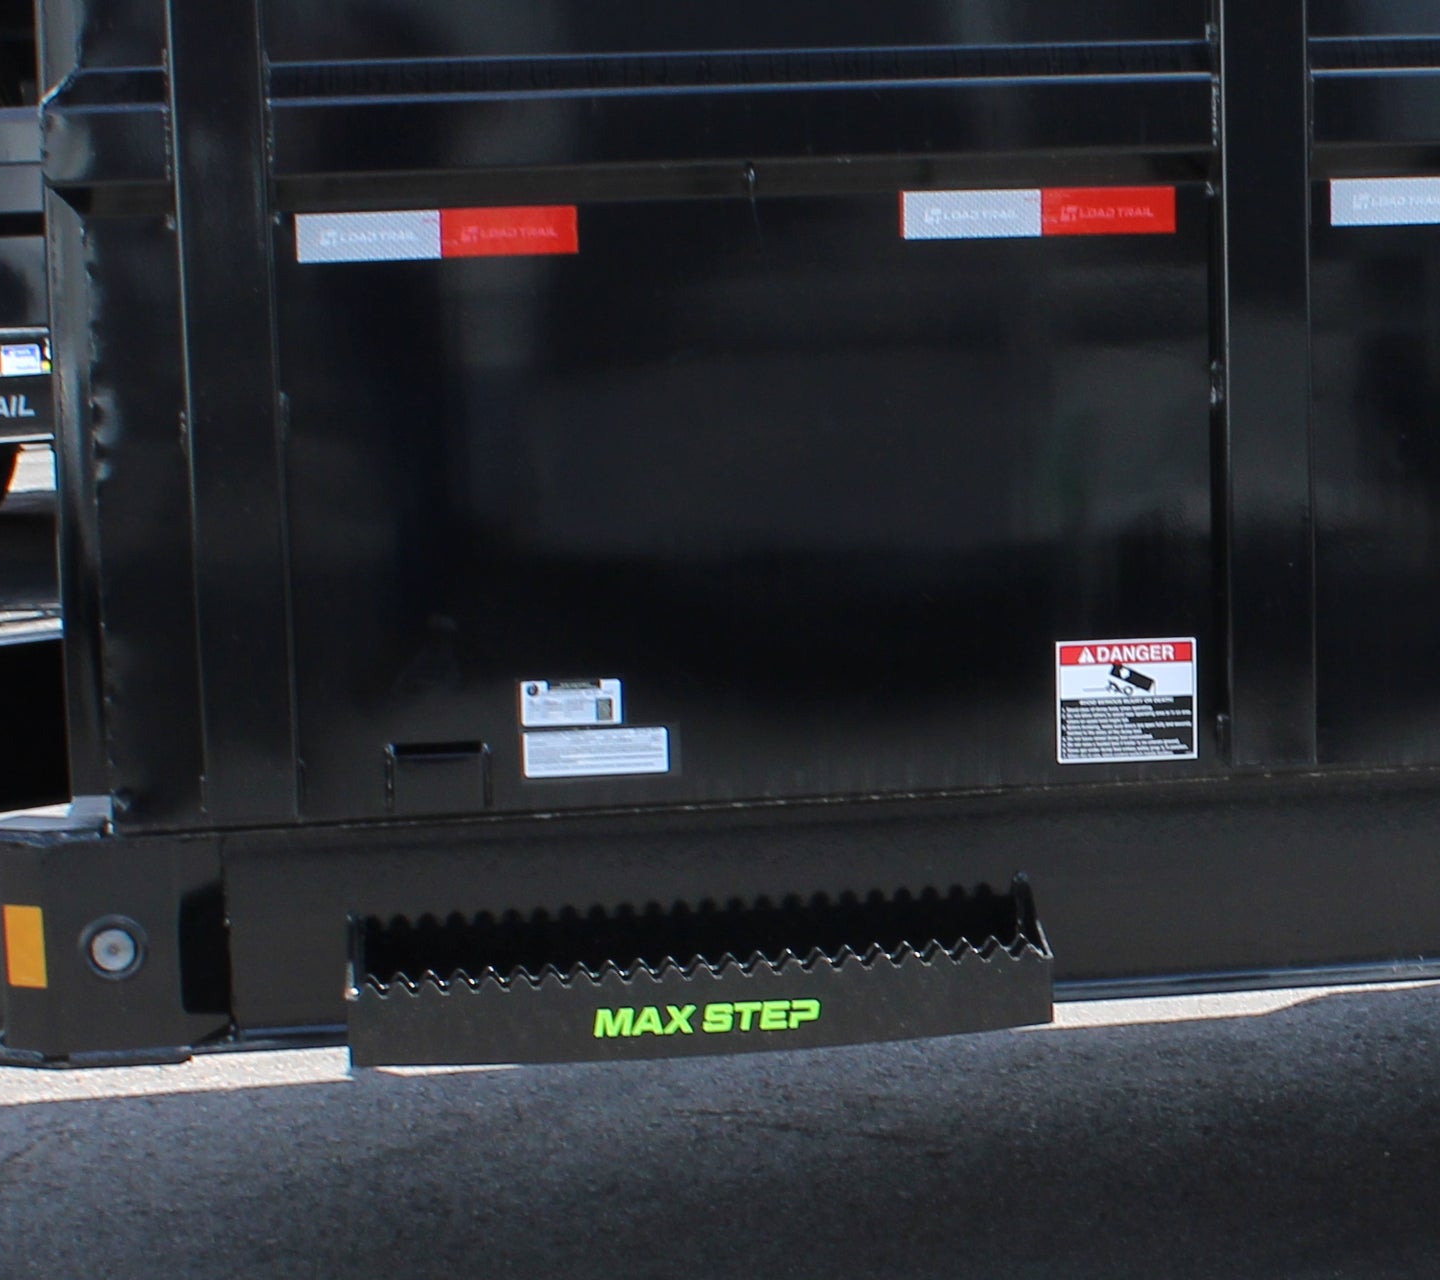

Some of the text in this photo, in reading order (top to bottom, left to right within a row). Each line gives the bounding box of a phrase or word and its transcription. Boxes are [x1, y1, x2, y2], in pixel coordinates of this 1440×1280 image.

[1096, 644, 1175, 663] DANGER
[593, 999, 821, 1038] MAX STEP
